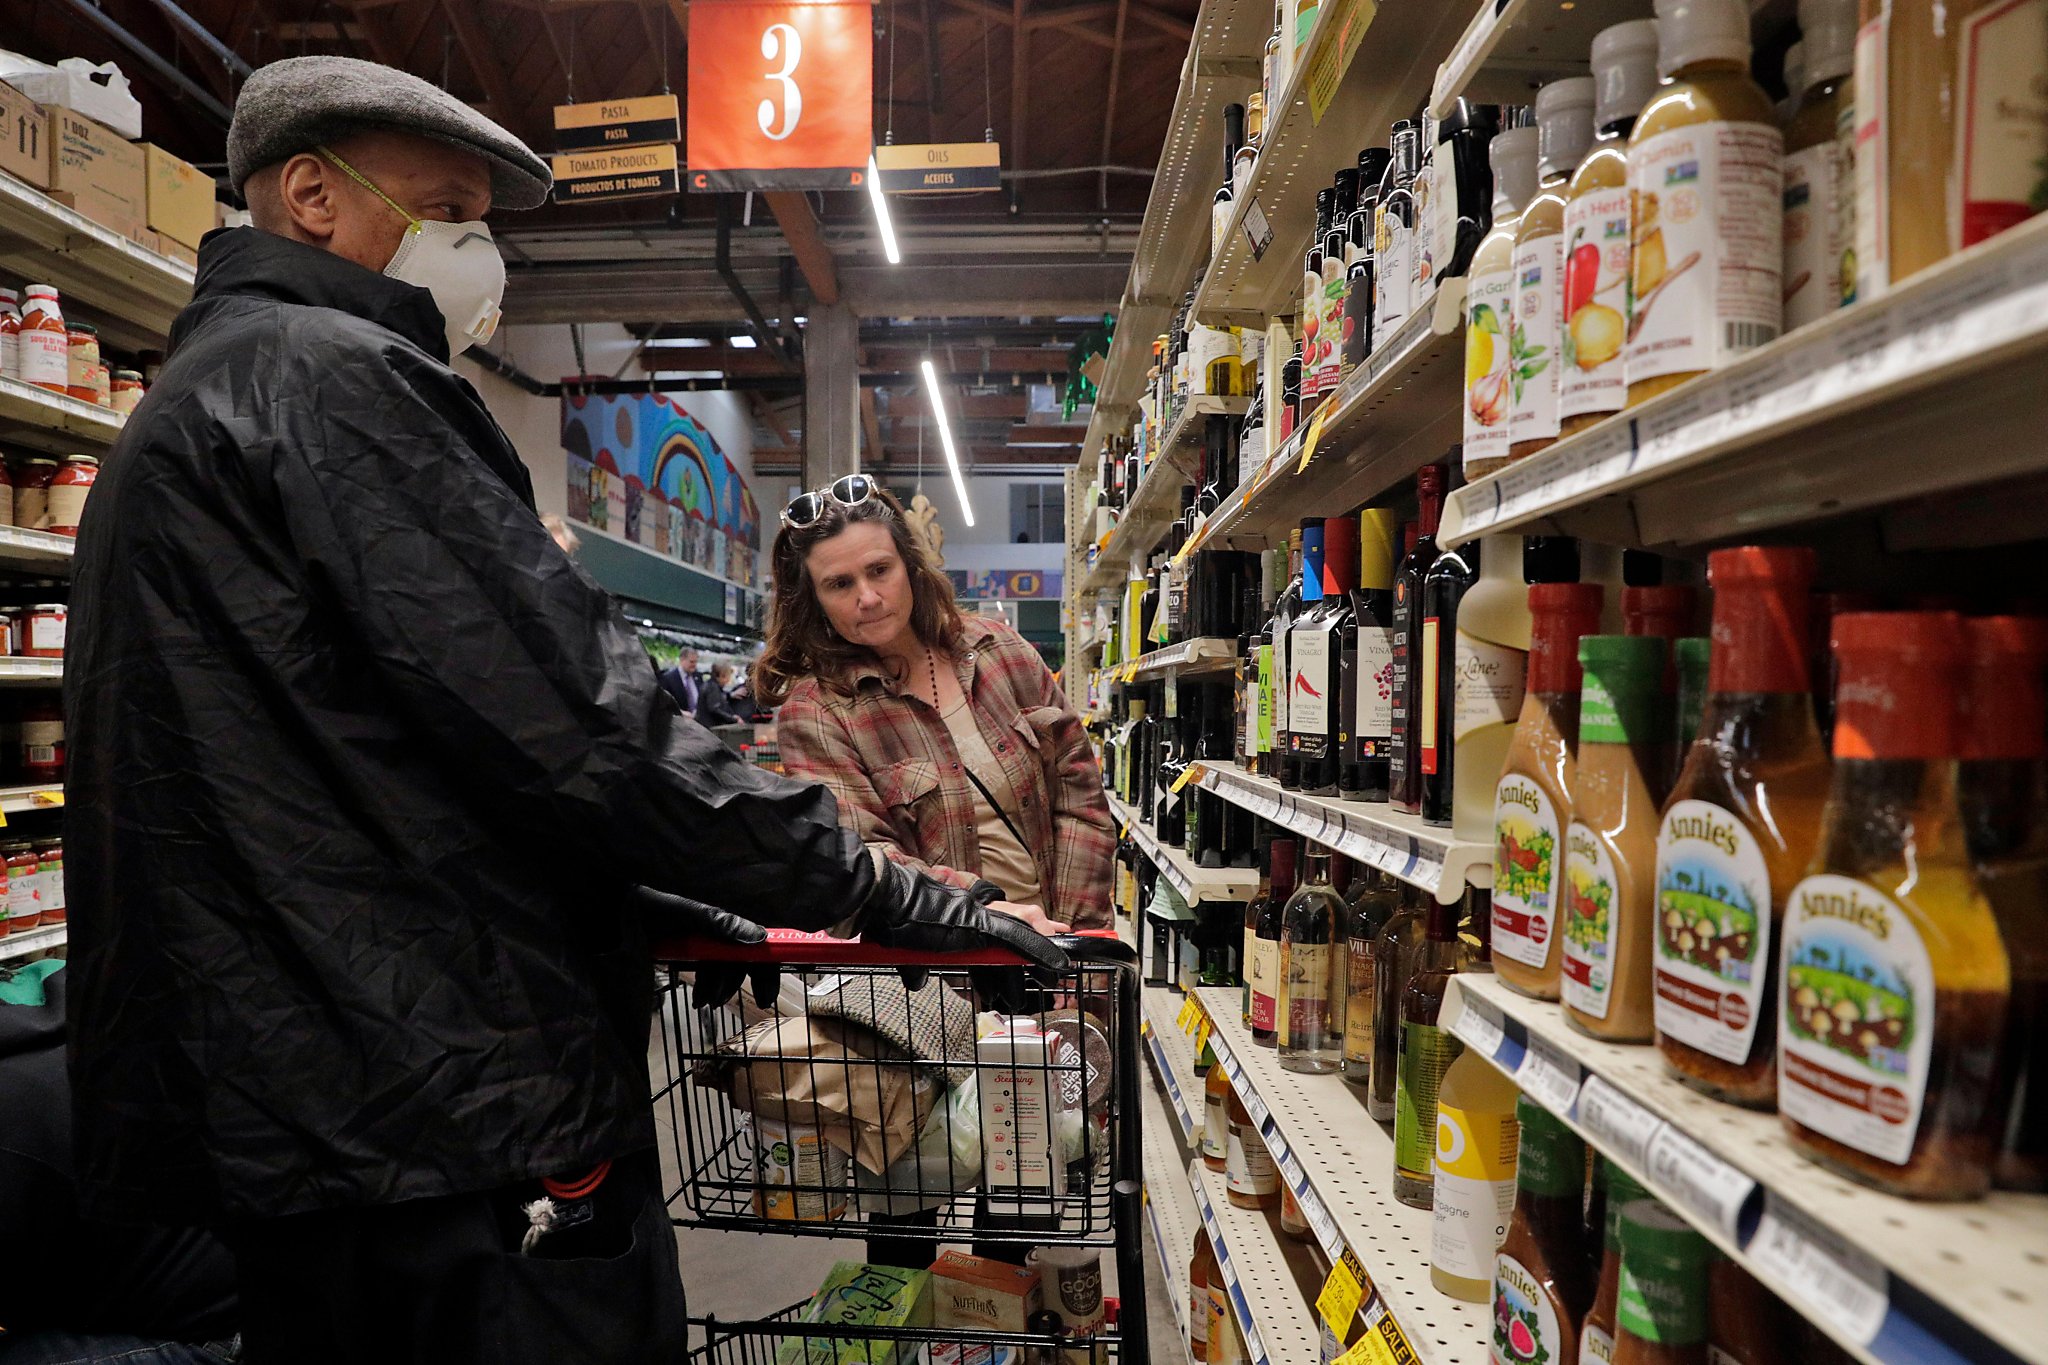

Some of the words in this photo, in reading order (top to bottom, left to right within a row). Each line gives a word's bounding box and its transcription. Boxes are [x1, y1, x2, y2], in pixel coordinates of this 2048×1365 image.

[757, 23, 802, 141] 3
[601, 106, 630, 119] PASTA
[604, 128, 629, 140] PASTA
[569, 158, 608, 173] TOMATO
[610, 153, 658, 169] PRODUCTS
[927, 150, 949, 163] OILS
[570, 180, 615, 195] PRODUCTOS
[615, 178, 627, 190] DE
[627, 175, 661, 189] TOMATES
[694, 175, 707, 188] C
[851, 172, 863, 185] D
[923, 173, 954, 184] ACEITES
[1369, 646, 1392, 654] VINA
[1668, 810, 1739, 857] Annie's
[1801, 890, 1892, 941] Annie's
[1344, 1250, 1365, 1285] SALE
[1061, 1270, 1101, 1294] GOOD
[1381, 1320, 1409, 1363] SALE
